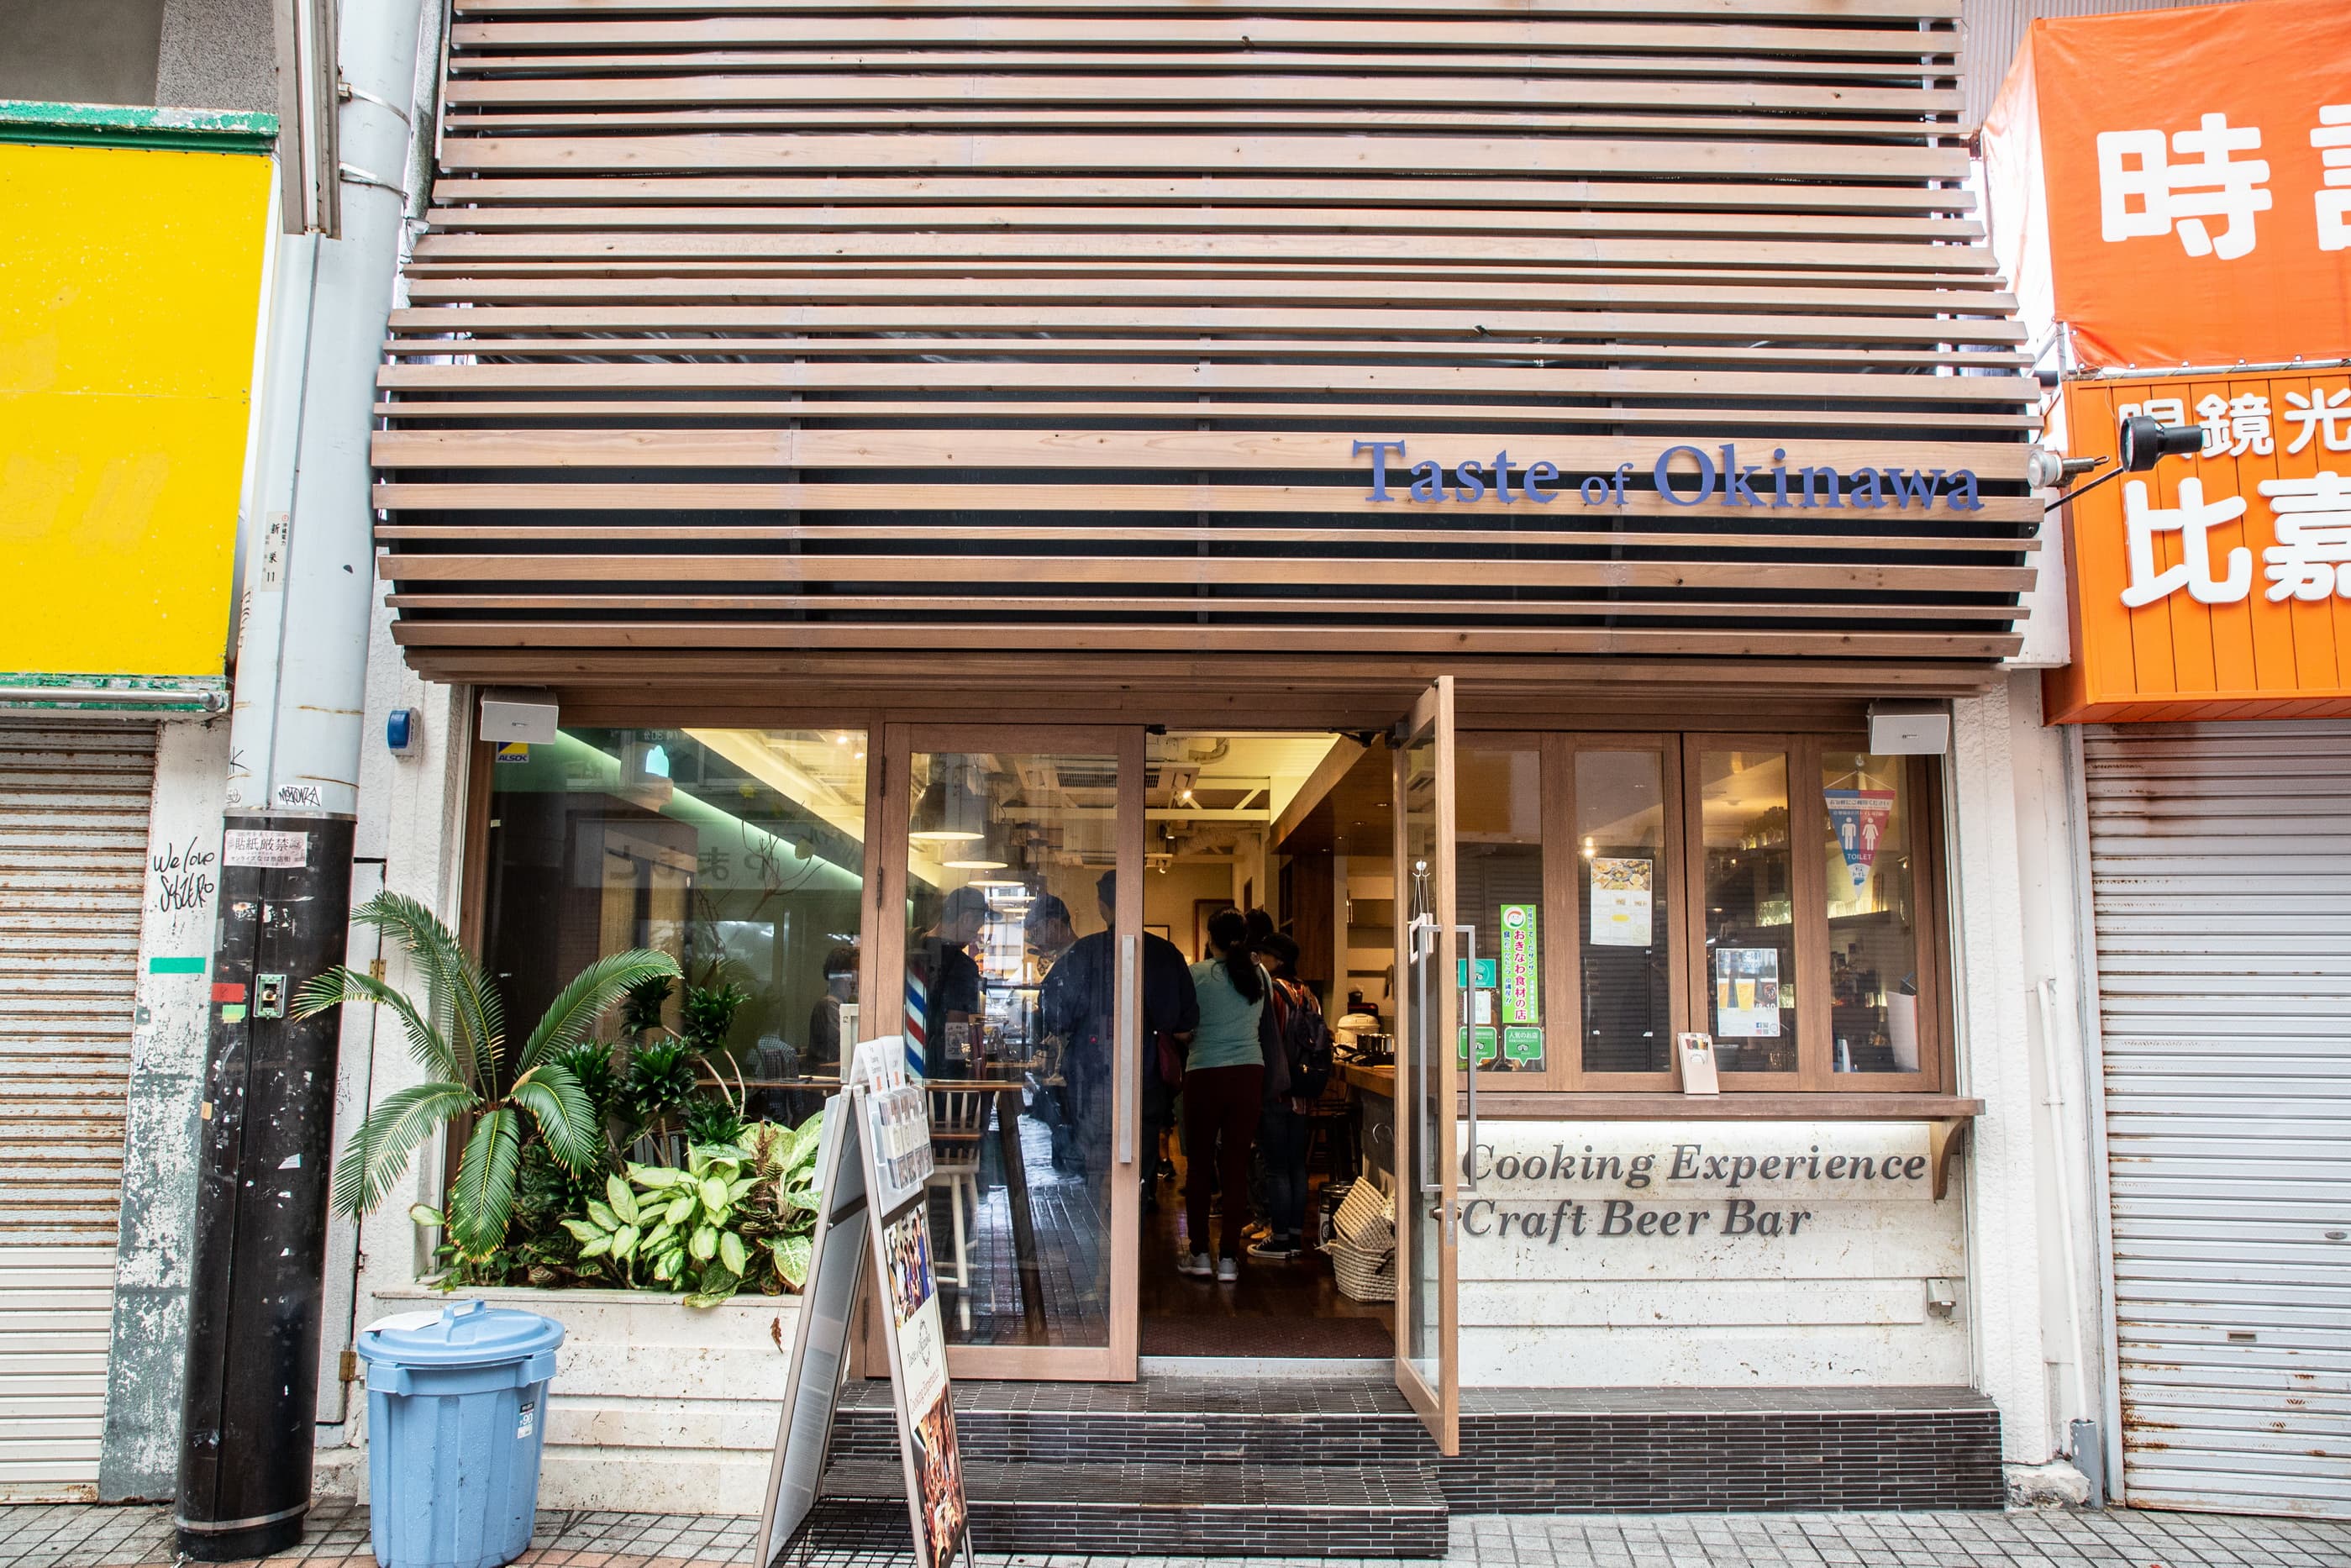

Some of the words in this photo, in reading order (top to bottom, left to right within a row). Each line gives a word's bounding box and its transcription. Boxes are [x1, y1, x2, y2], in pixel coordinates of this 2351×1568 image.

[2096, 104, 2351, 260] 時
[1352, 439, 1559, 503] Taste
[1580, 462, 1634, 505] of
[1654, 443, 1985, 511] Okinawa
[235, 838, 289, 851] 貼紙厳禁
[1514, 929, 1526, 1020] おきなわ食材の店
[1462, 1144, 1656, 1188] Cooking
[1666, 1144, 1926, 1187] Experience
[1462, 1199, 1586, 1244] Craft
[1597, 1199, 1710, 1236] Beer
[1720, 1198, 1812, 1237] Bar
